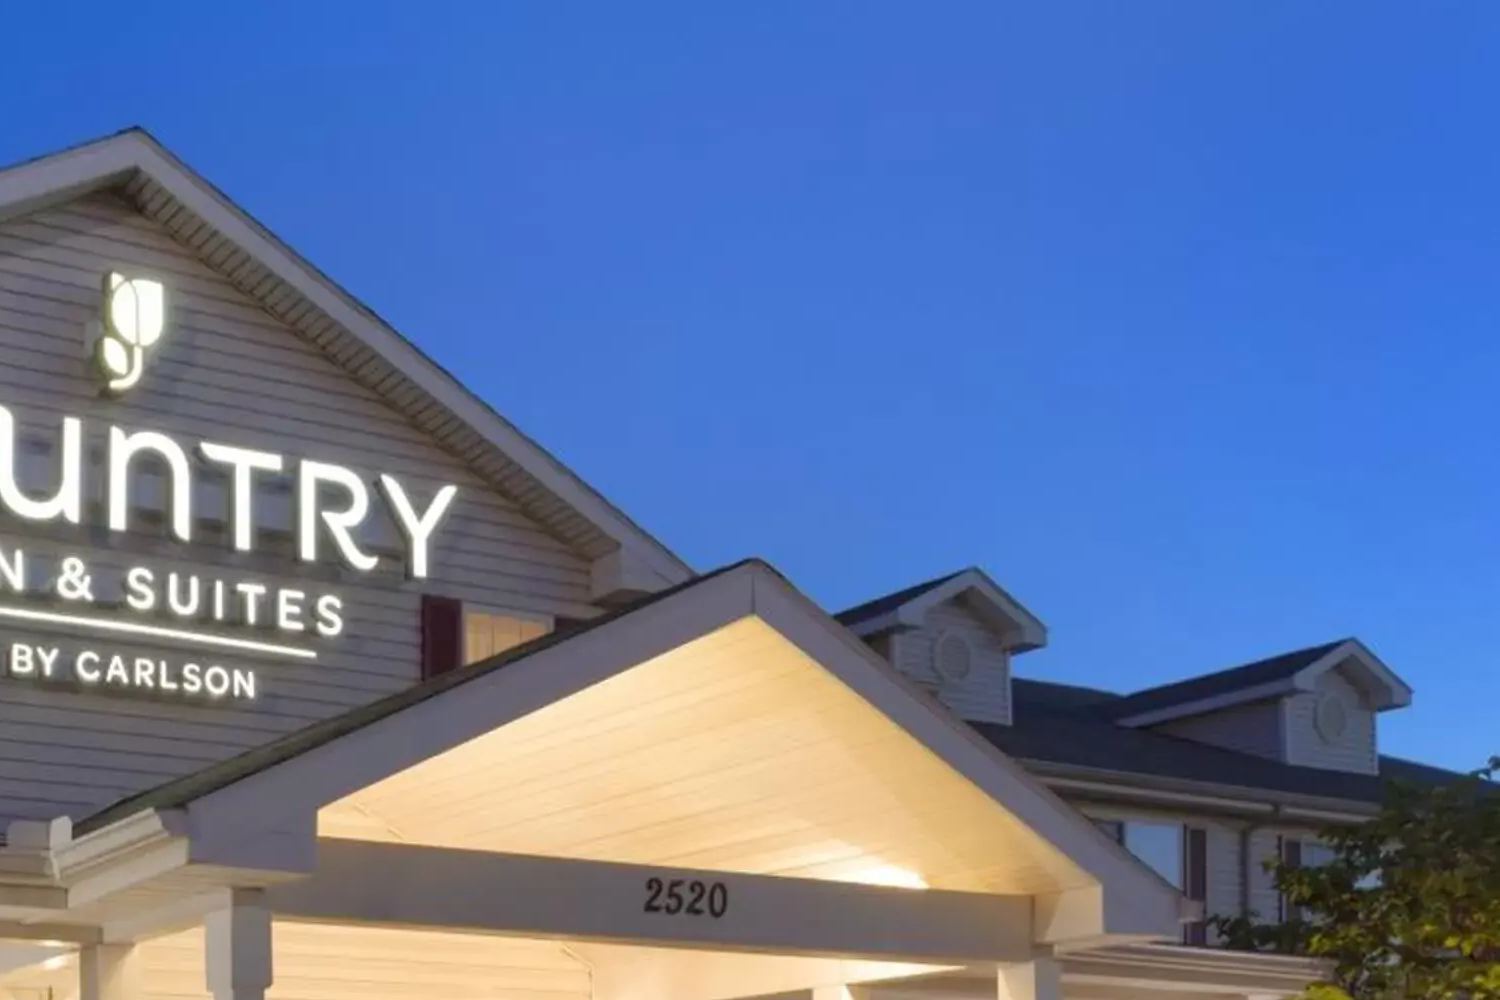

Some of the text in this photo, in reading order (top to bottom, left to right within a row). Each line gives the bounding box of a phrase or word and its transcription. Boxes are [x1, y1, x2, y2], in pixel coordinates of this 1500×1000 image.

[56, 556, 94, 601] &
[126, 567, 343, 636] SUITES
[11, 643, 255, 698] BY CARLSON
[643, 876, 728, 918] 2520
